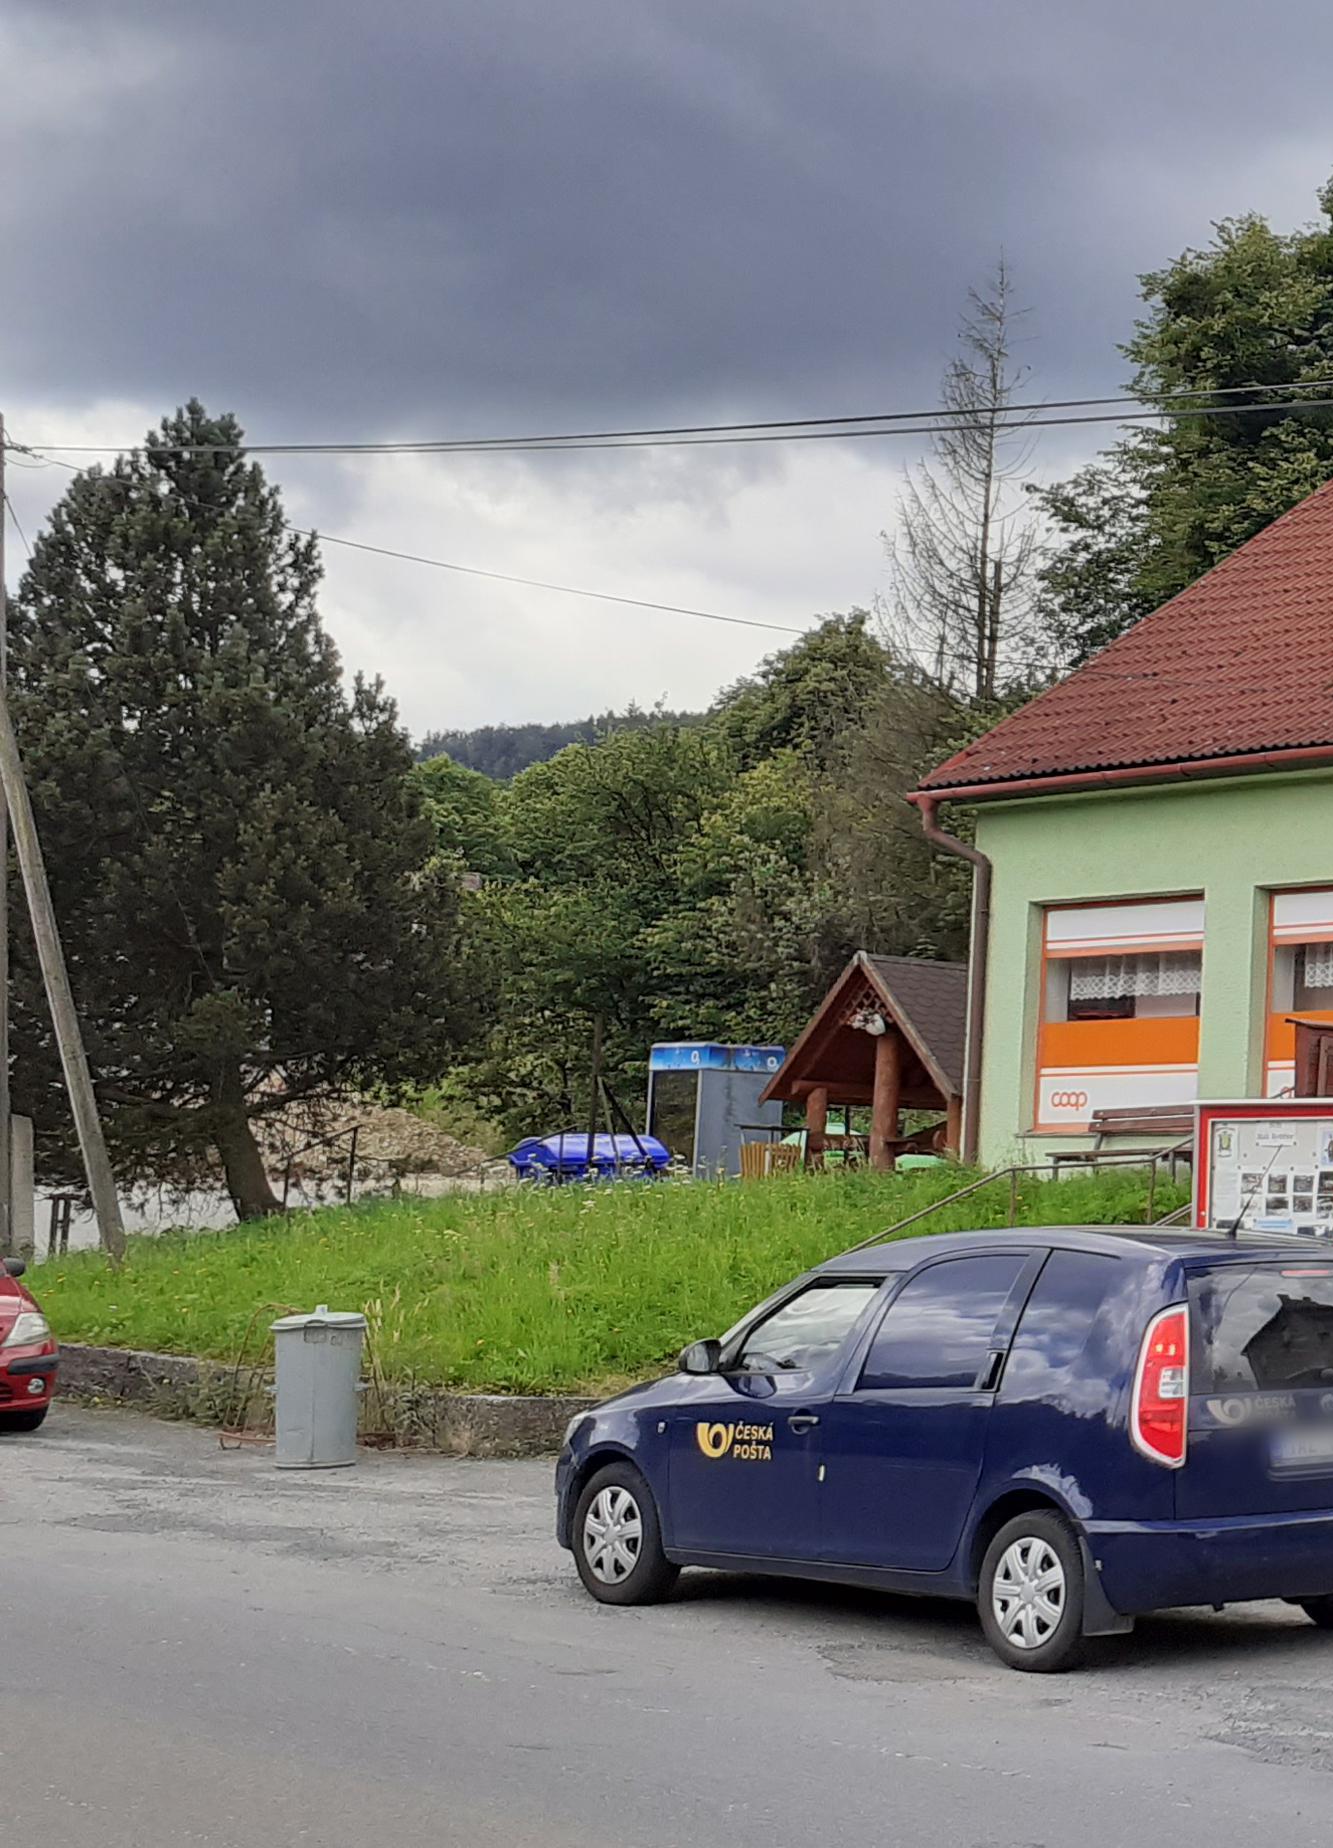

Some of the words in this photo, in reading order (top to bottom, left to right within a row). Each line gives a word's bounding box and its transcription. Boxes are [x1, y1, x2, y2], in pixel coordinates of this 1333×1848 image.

[1254, 1393, 1297, 1410] ČESKÁ
[735, 1420, 774, 1441] ČESKÁ
[733, 1440, 772, 1461] POŠTA
